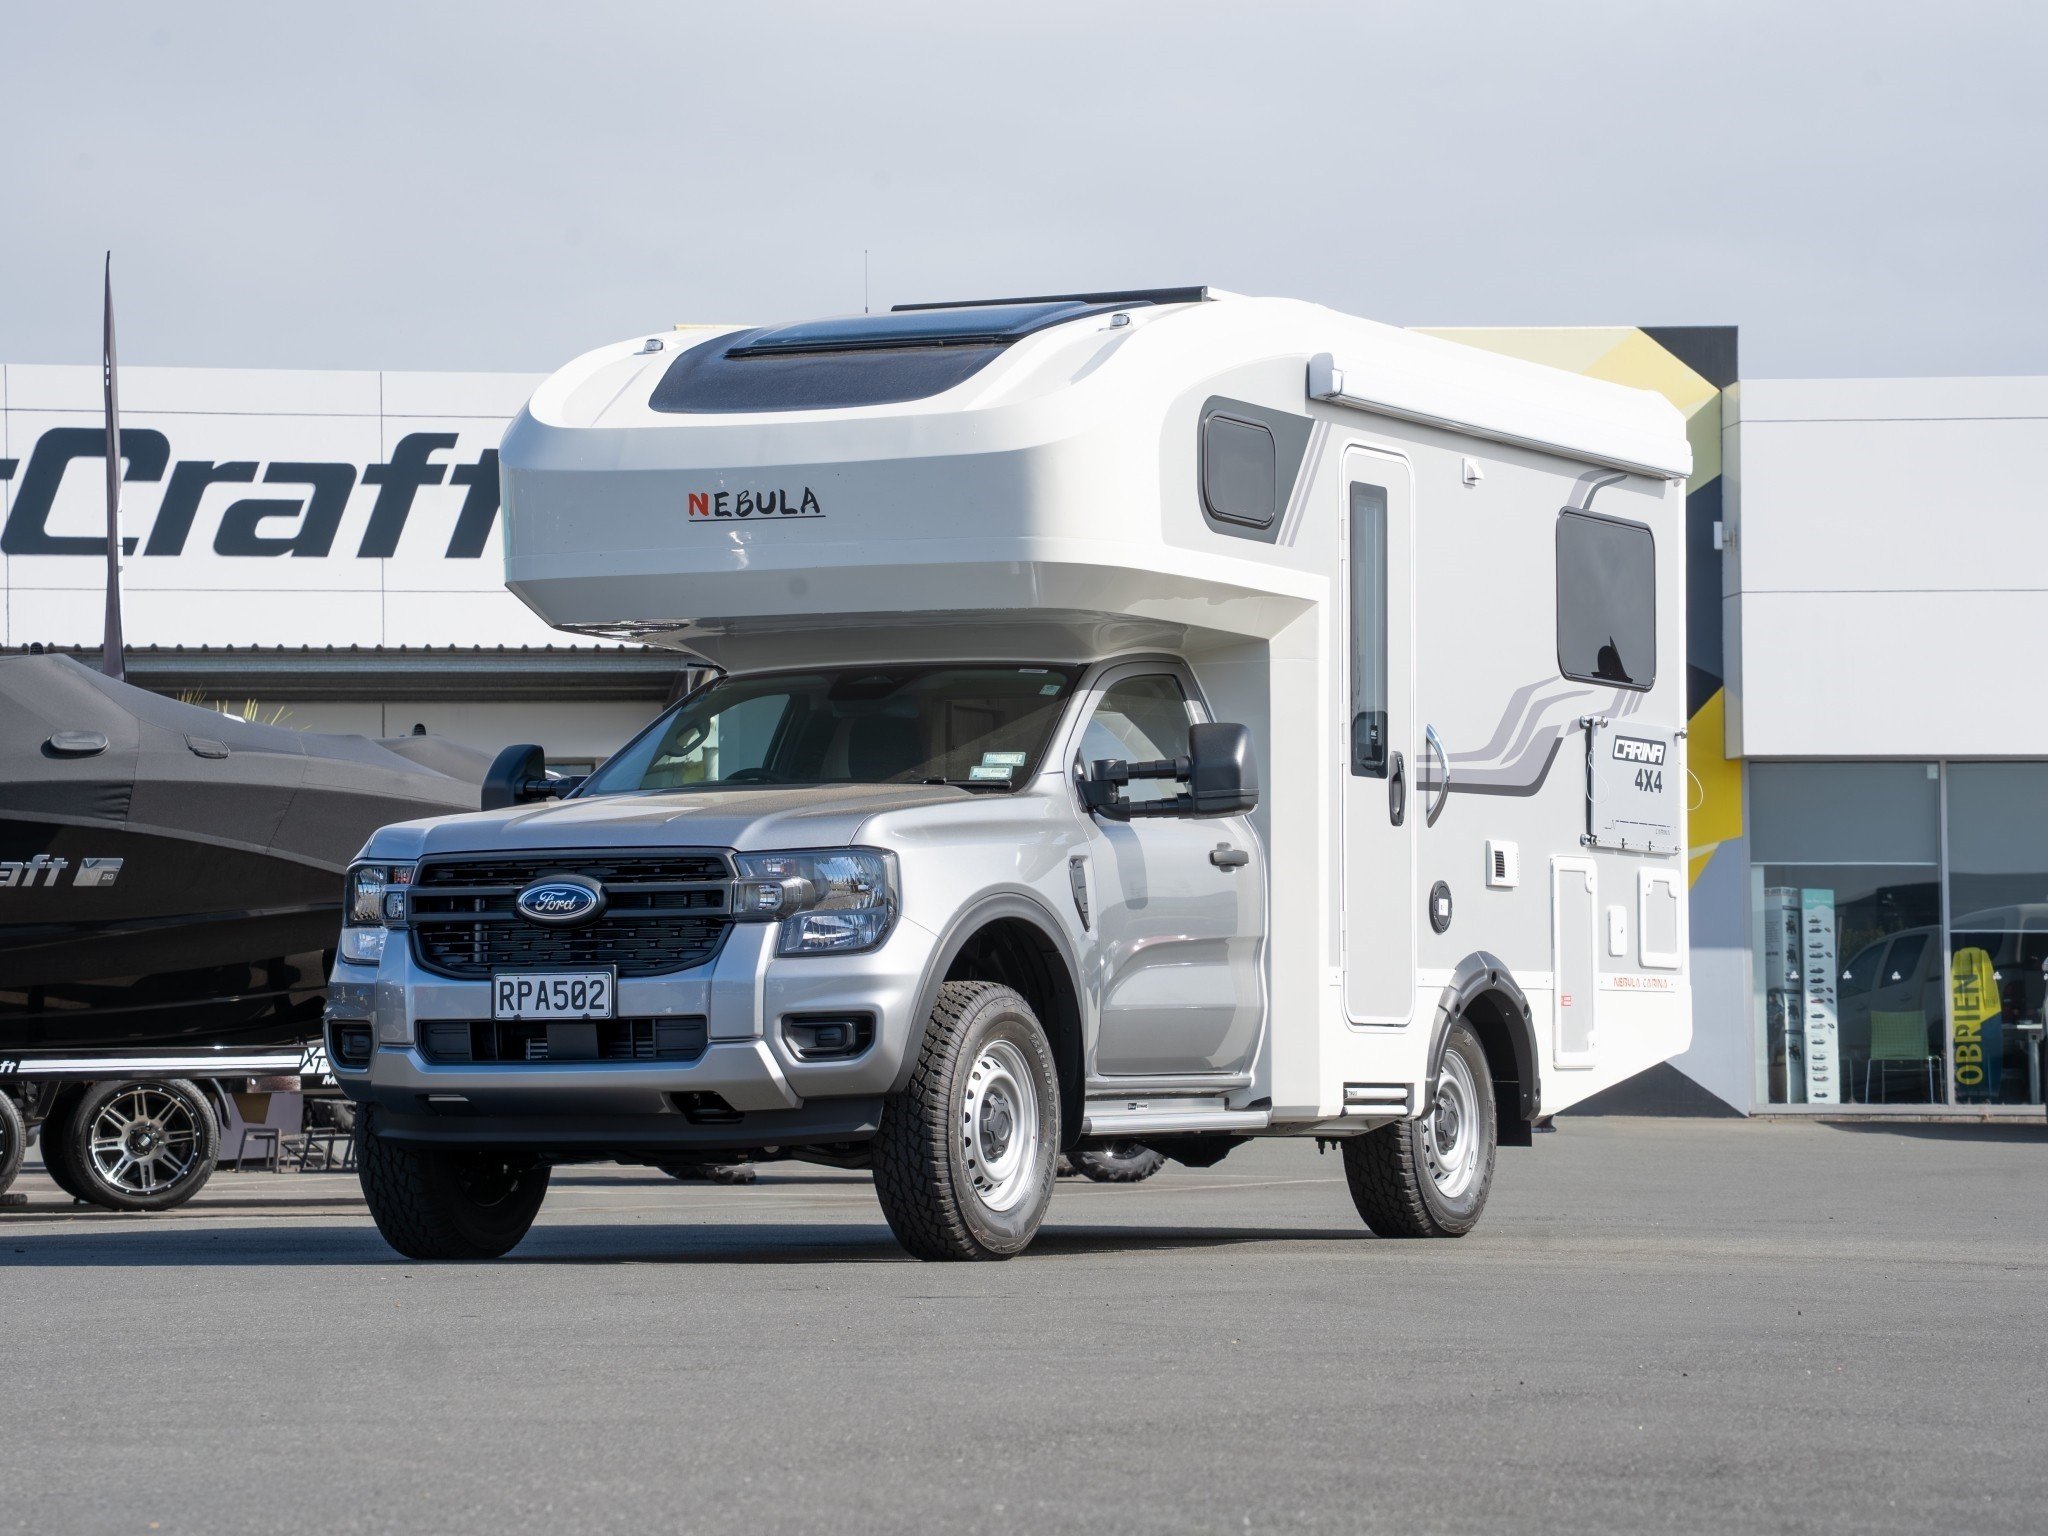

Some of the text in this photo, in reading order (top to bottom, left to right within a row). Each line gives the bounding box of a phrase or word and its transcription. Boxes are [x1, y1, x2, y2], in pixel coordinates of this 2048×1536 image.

[688, 486, 826, 522] NEBULA
[1614, 738, 1665, 764] CARINA
[1635, 768, 1662, 793] 4X4
[535, 891, 576, 911] Ford
[499, 980, 605, 1011] RPA502
